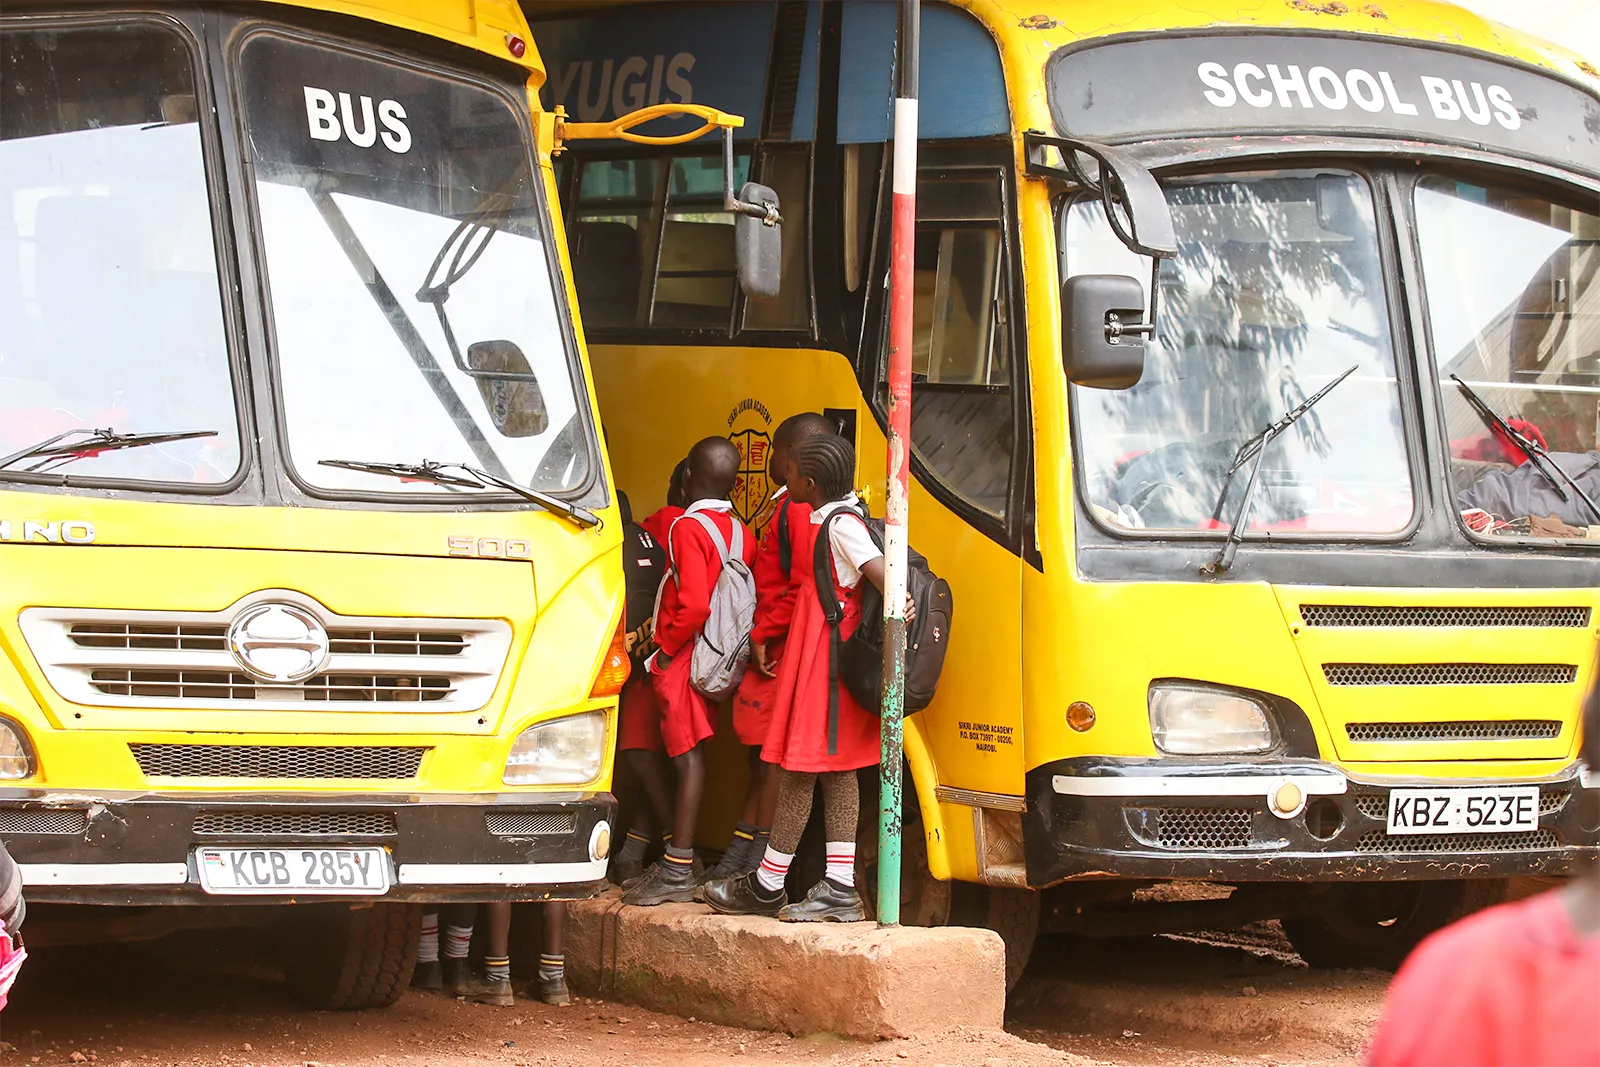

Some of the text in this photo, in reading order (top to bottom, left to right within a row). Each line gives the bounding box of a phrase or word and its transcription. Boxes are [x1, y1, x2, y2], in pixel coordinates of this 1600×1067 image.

[541, 52, 696, 121] YUGIS
[1197, 61, 1521, 131] SCHOOL BUS
[303, 86, 412, 153] BUS
[727, 398, 772, 428] SIKRI JUNIOR ACADEMY
[447, 536, 531, 559] 500
[958, 721, 1013, 734] SIKRI JUNIOR ACADEMY
[969, 732, 979, 740] BOX
[1393, 796, 1533, 827] KBZ 523E
[231, 852, 370, 886] KCB 285Y
